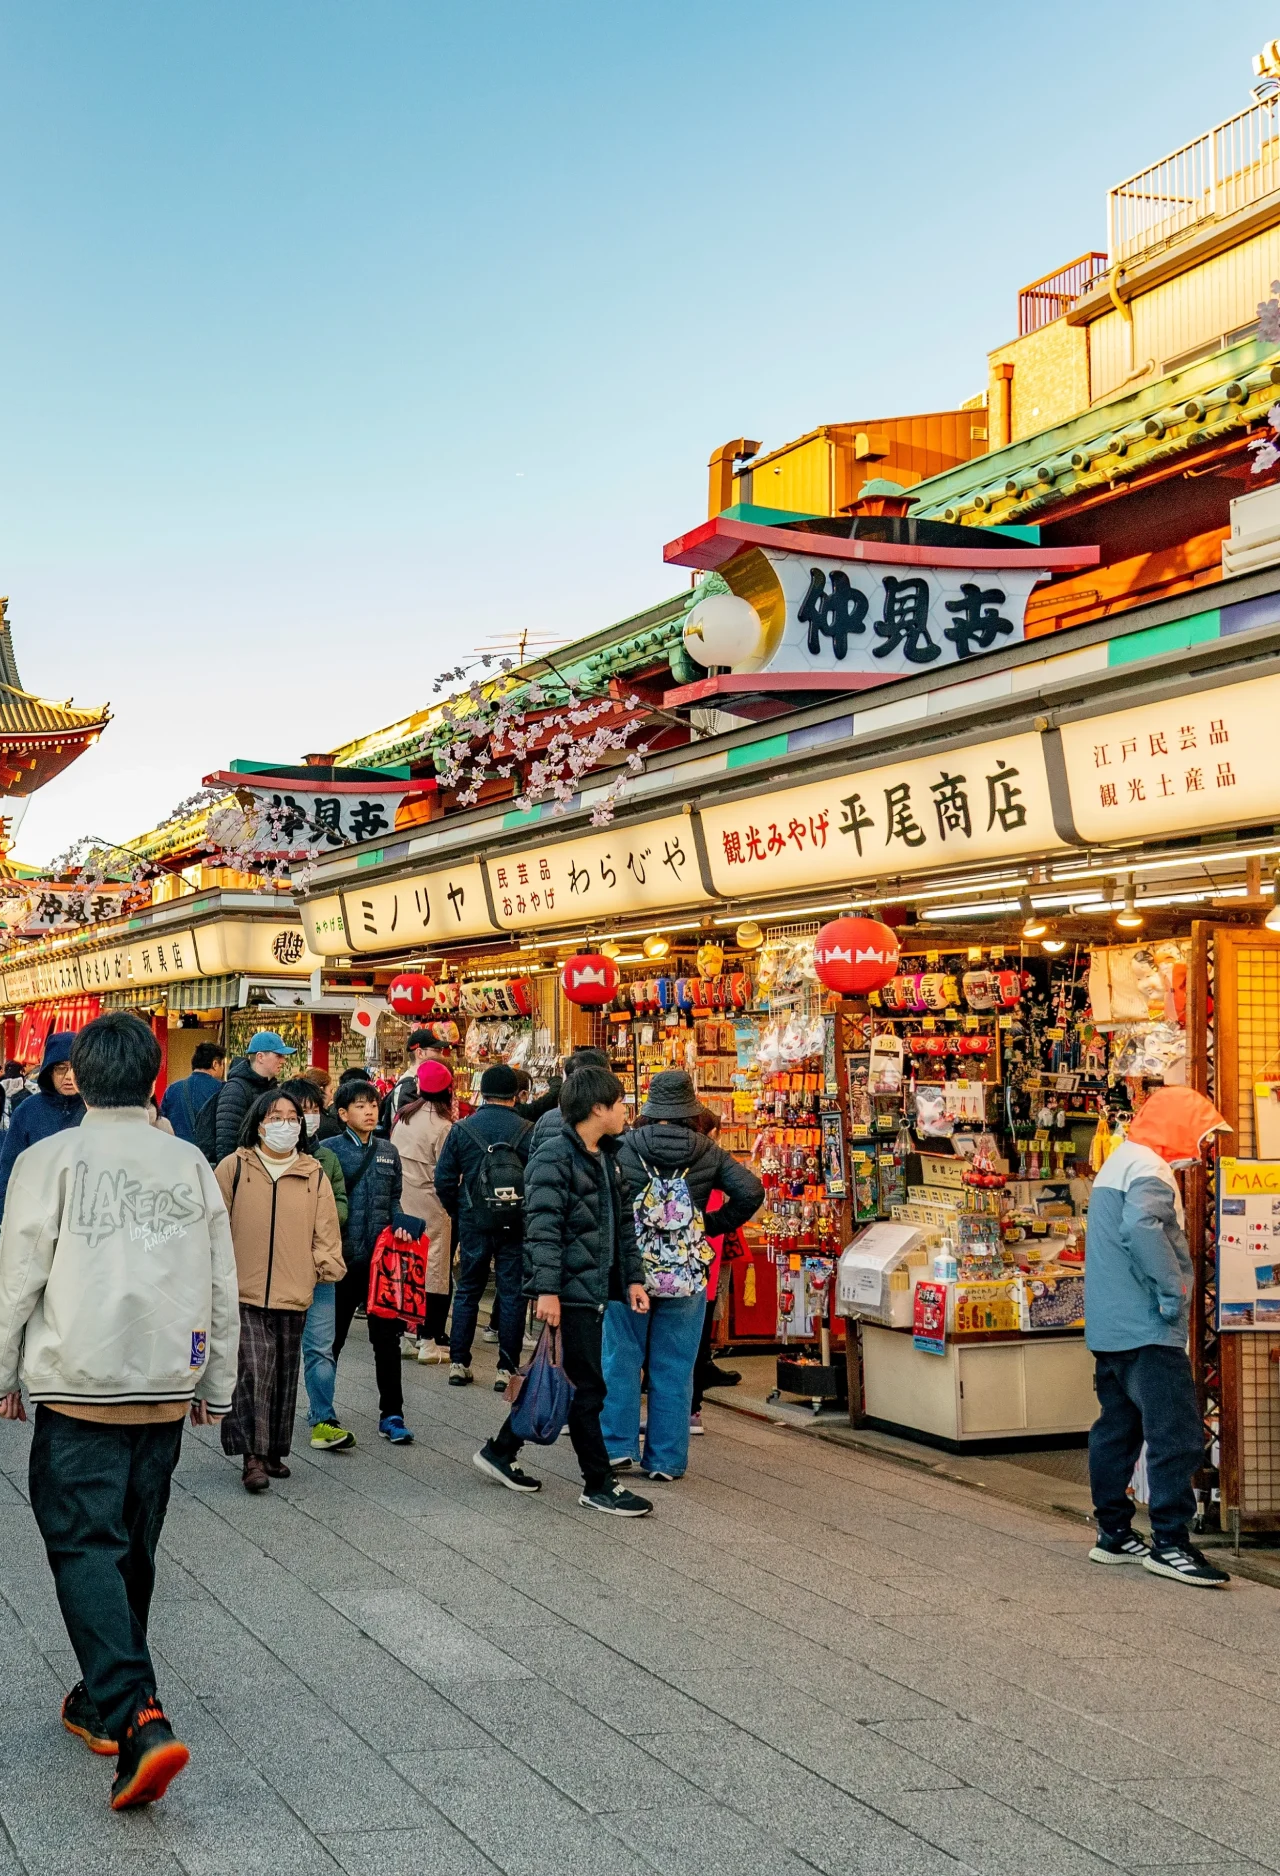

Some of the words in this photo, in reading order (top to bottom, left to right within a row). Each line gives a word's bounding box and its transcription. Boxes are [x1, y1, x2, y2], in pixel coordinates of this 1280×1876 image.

[797, 567, 1014, 663] 仲見世
[1093, 718, 1231, 768] 江戸民芸品
[1099, 762, 1237, 809] 観光土産品
[721, 810, 830, 867] 観光みやげ
[838, 759, 1028, 858] 平尾商店
[496, 858, 552, 890] 民芸品
[567, 837, 687, 895] わらびや
[315, 916, 345, 935] みやげ品
[361, 882, 465, 935] ミノリヤ
[502, 887, 555, 918] おみやげ
[141, 942, 184, 974] 玩具店
[68, 1160, 207, 1248] LAKERS
[129, 1221, 152, 1242] LOS
[143, 1225, 188, 1253] ANGELES
